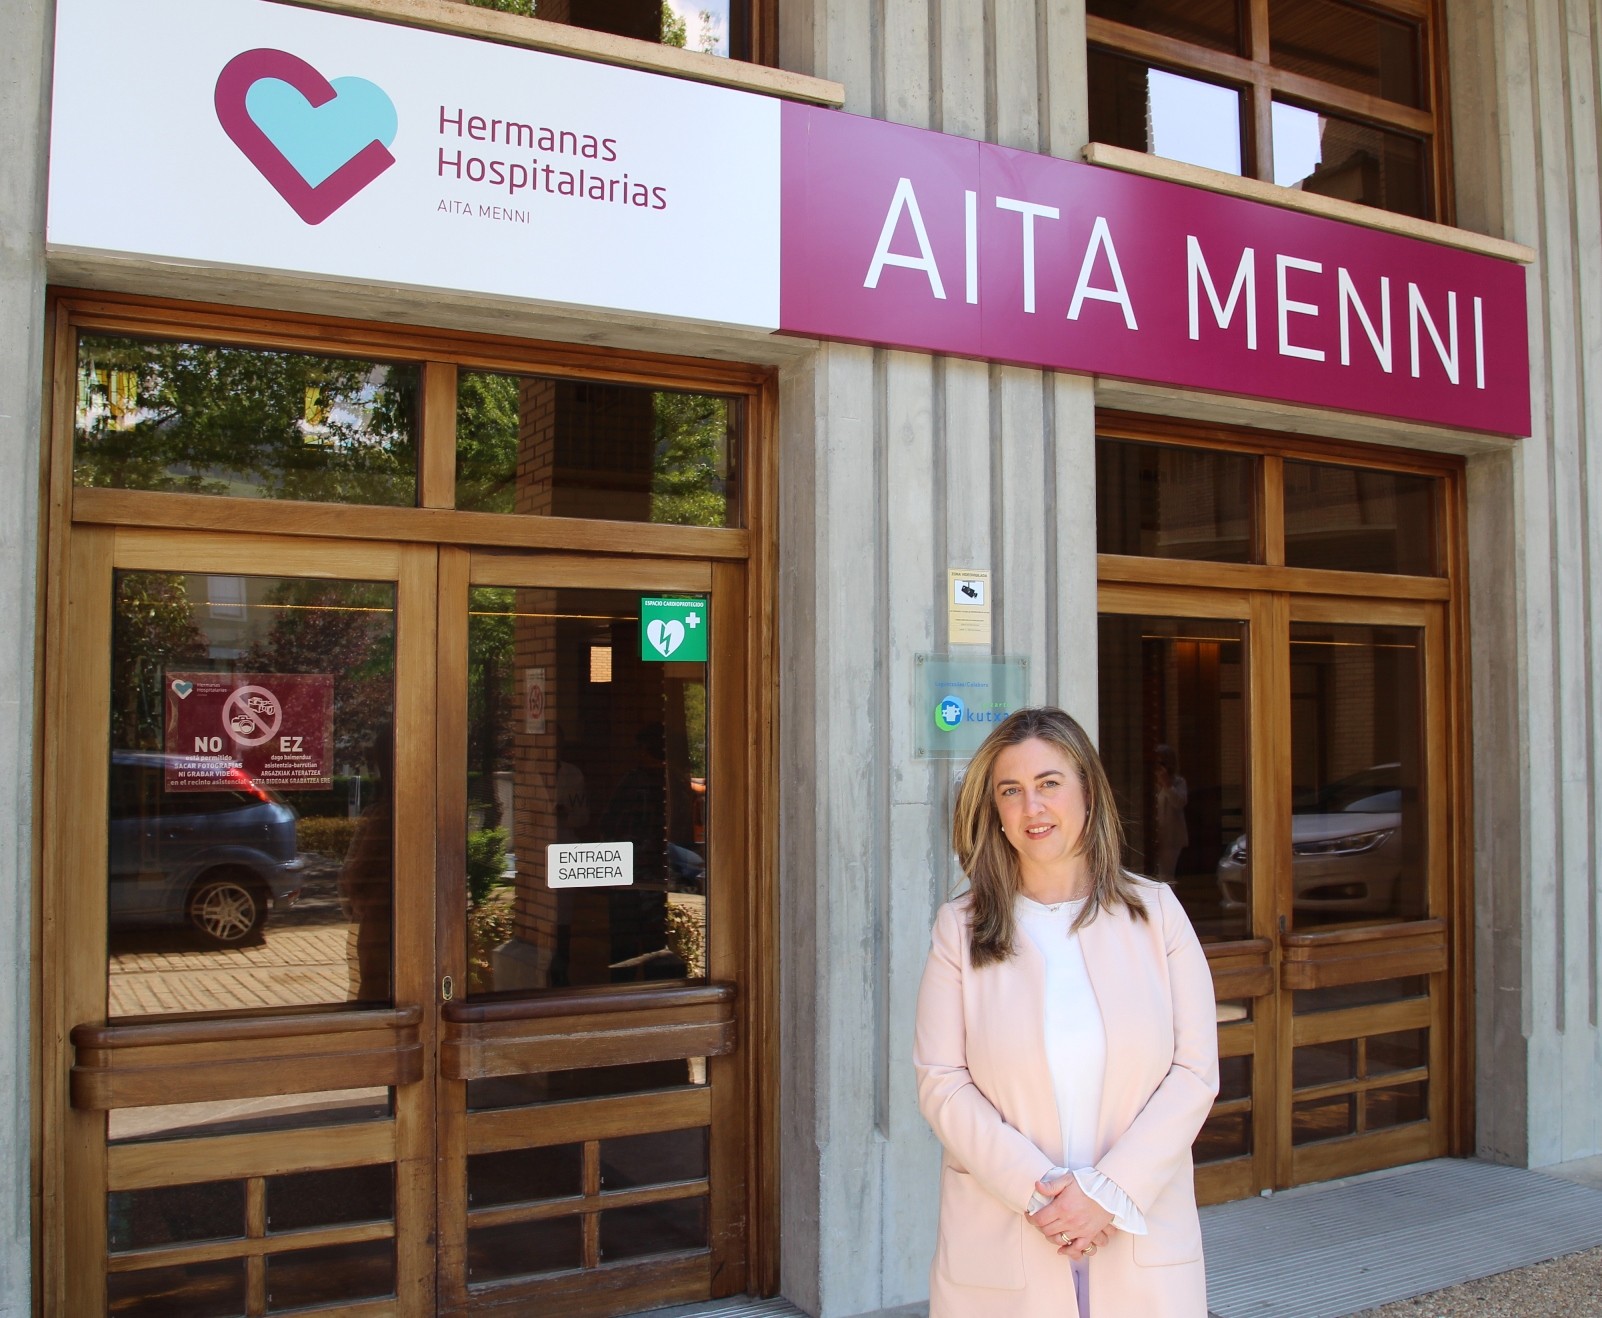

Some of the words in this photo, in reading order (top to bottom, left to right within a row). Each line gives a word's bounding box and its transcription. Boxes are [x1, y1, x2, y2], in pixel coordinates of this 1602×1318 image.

[439, 105, 617, 162] Hermanas
[438, 147, 667, 210] Hospitalarias
[437, 199, 473, 216] AITA
[478, 204, 531, 224] MENNI
[863, 177, 1138, 331] AITA
[1186, 234, 1486, 390] MENNI
[195, 737, 222, 752] NO
[280, 737, 303, 752] EZ
[559, 850, 622, 864] ENTRADA
[558, 866, 623, 880] SARRERA
